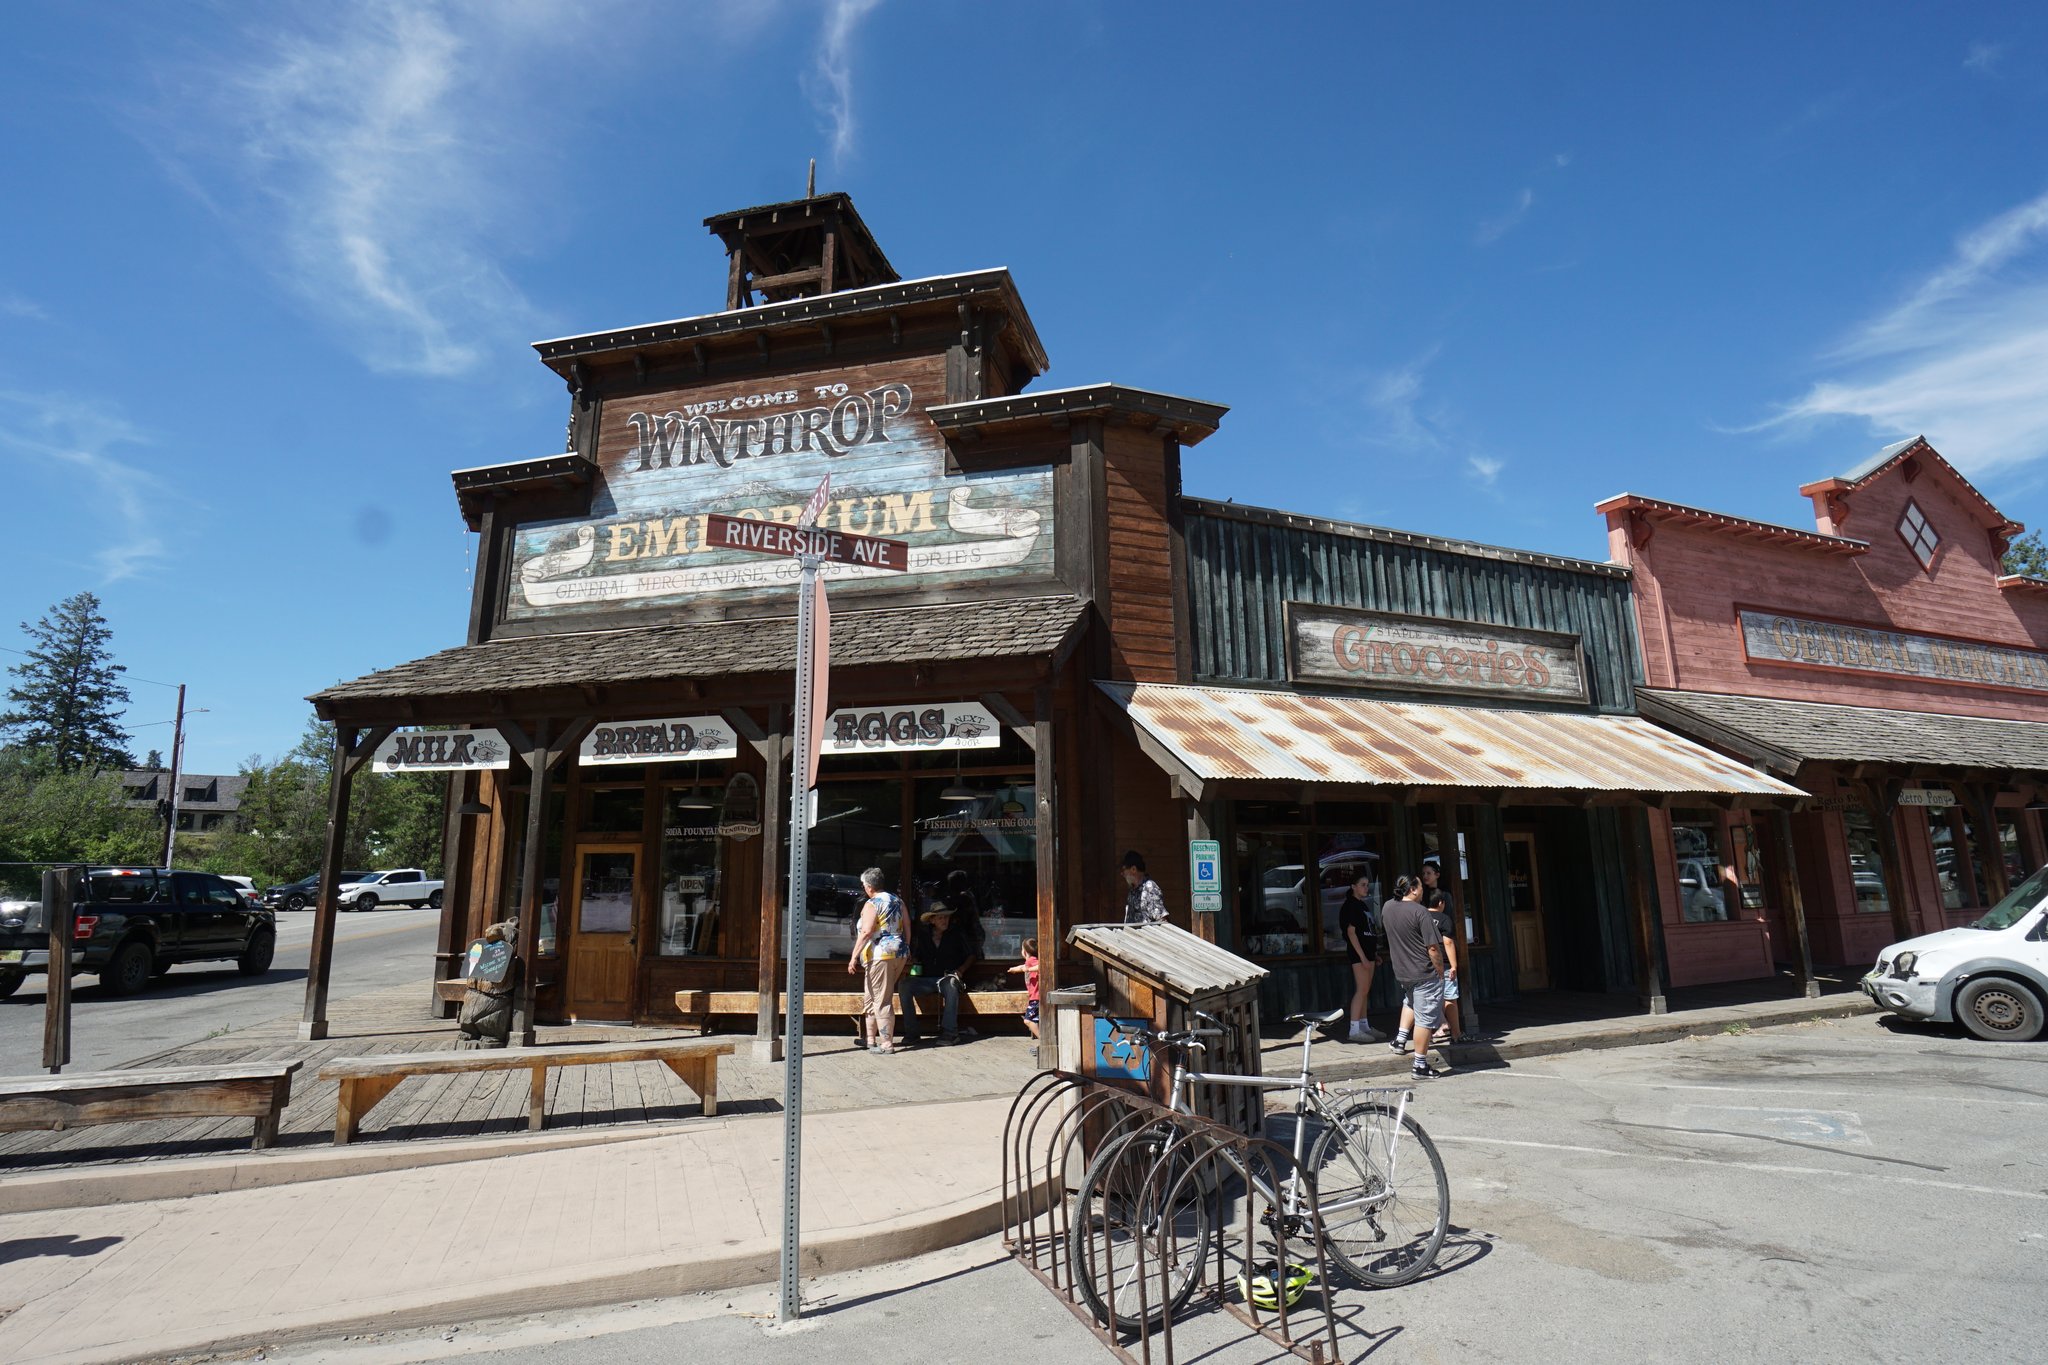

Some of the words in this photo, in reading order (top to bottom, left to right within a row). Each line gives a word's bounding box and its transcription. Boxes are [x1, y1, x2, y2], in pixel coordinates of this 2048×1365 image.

[683, 389, 799, 417] WELCOME
[814, 383, 849, 398] TO
[626, 383, 913, 473] WINTHROP
[725, 520, 842, 558] RIVERSIDE
[852, 539, 891, 565] AVE
[556, 580, 628, 599] GENERAL
[775, 560, 841, 579] GODS
[1377, 627, 1421, 639] STAPLE
[1445, 635, 1482, 645] FANCY
[1772, 616, 1920, 673] GENERAL
[1332, 623, 1551, 689] Groceries
[954, 714, 985, 724] NEXT
[698, 728, 722, 737] NEXT
[833, 708, 946, 750] EGGS
[478, 739, 498, 748] NEXT
[592, 722, 696, 761] BREAD
[387, 733, 475, 770] MILK
[1900, 791, 1923, 804] Retro
[665, 827, 682, 836] SODA
[683, 827, 720, 836] FOUNTAI
[721, 824, 760, 834] TENDERFOOT
[924, 819, 963, 829] FISHING
[971, 818, 1017, 829] SPORTING
[1193, 844, 1217, 852] RESERVED
[681, 879, 705, 890] OPEN
